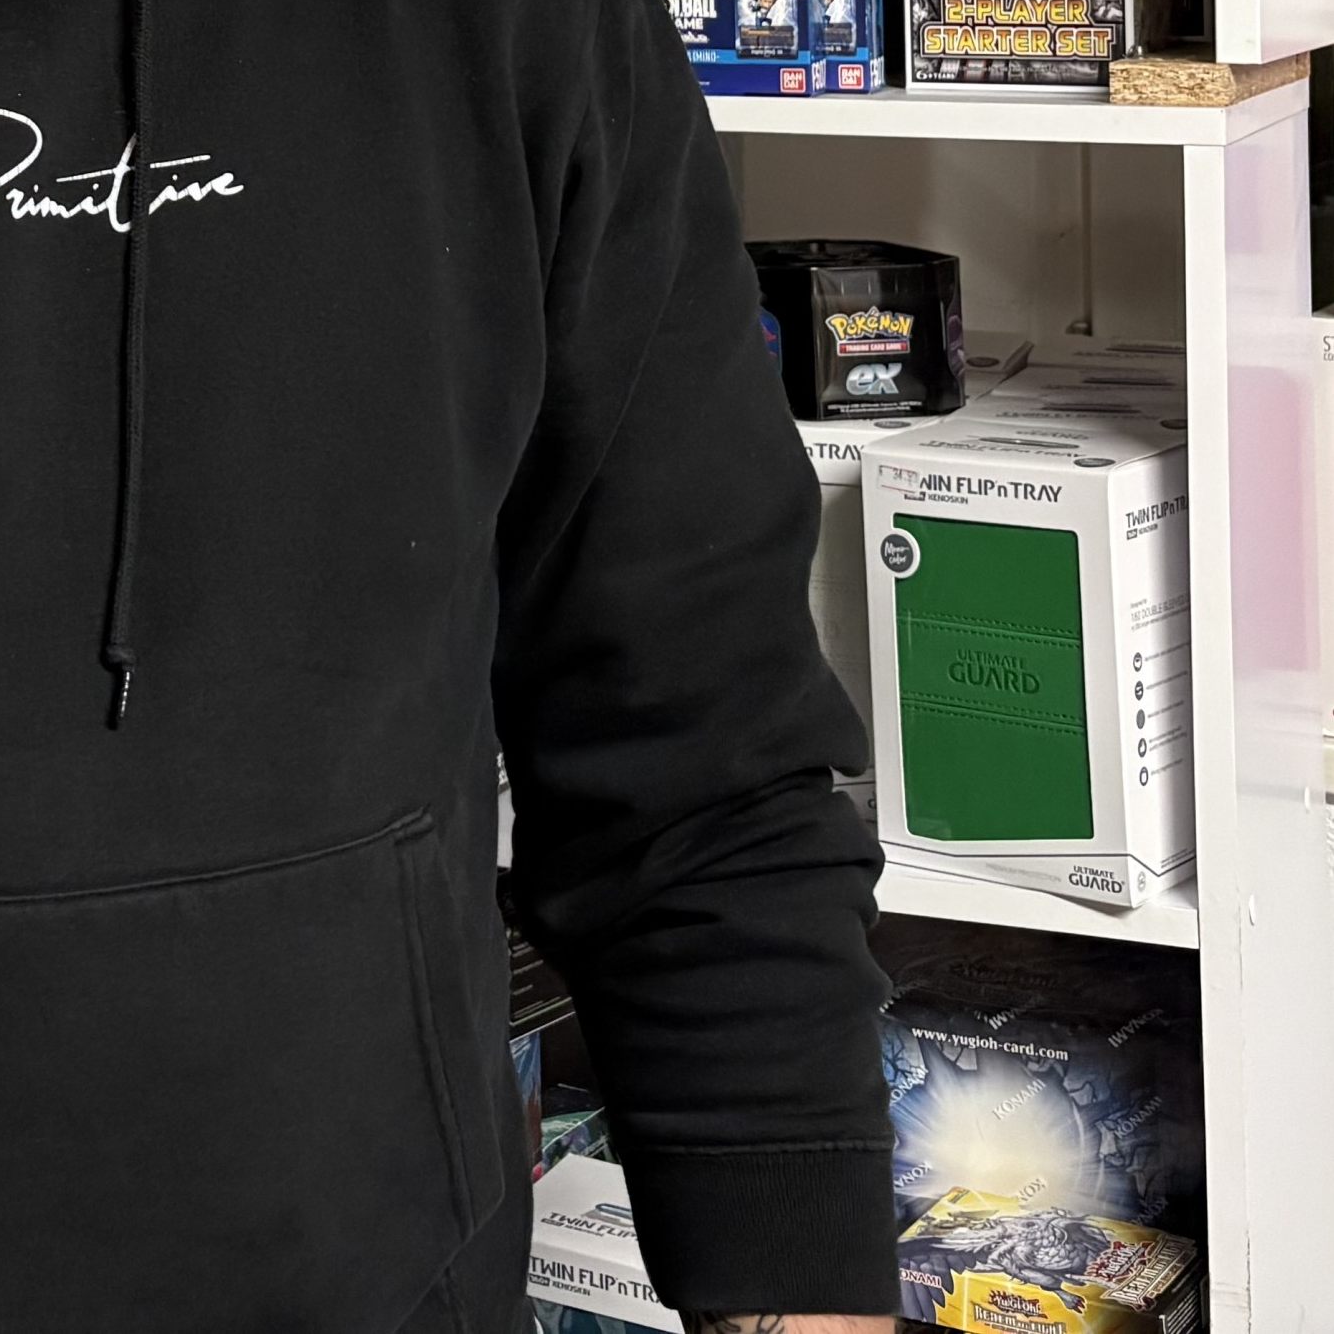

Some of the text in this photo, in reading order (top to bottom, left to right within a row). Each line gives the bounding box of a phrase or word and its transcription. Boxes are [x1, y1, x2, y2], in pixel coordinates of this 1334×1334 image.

[676, 17, 703, 30] AME
[925, 27, 1109, 56] STARTER SET
[847, 362, 903, 396] ex
[812, 442, 864, 464] TRAY
[927, 493, 969, 505] XENOSKIN
[1125, 507, 1150, 529] TWIN
[956, 649, 1026, 670] ULTIMATE
[947, 661, 1041, 696] GUARD
[1068, 872, 1123, 894] GUARD
[1073, 865, 1115, 879] ULTIMATE
[911, 1027, 1070, 1062] www.yugioh-card.com
[889, 1064, 930, 1107] ONAMI
[993, 1078, 1047, 1122] KONAMI
[1112, 1095, 1164, 1139] KONAMI
[550, 1212, 594, 1229] TWIN
[530, 1255, 575, 1285] TWIN
[552, 1280, 591, 1297] XENOSKIN
